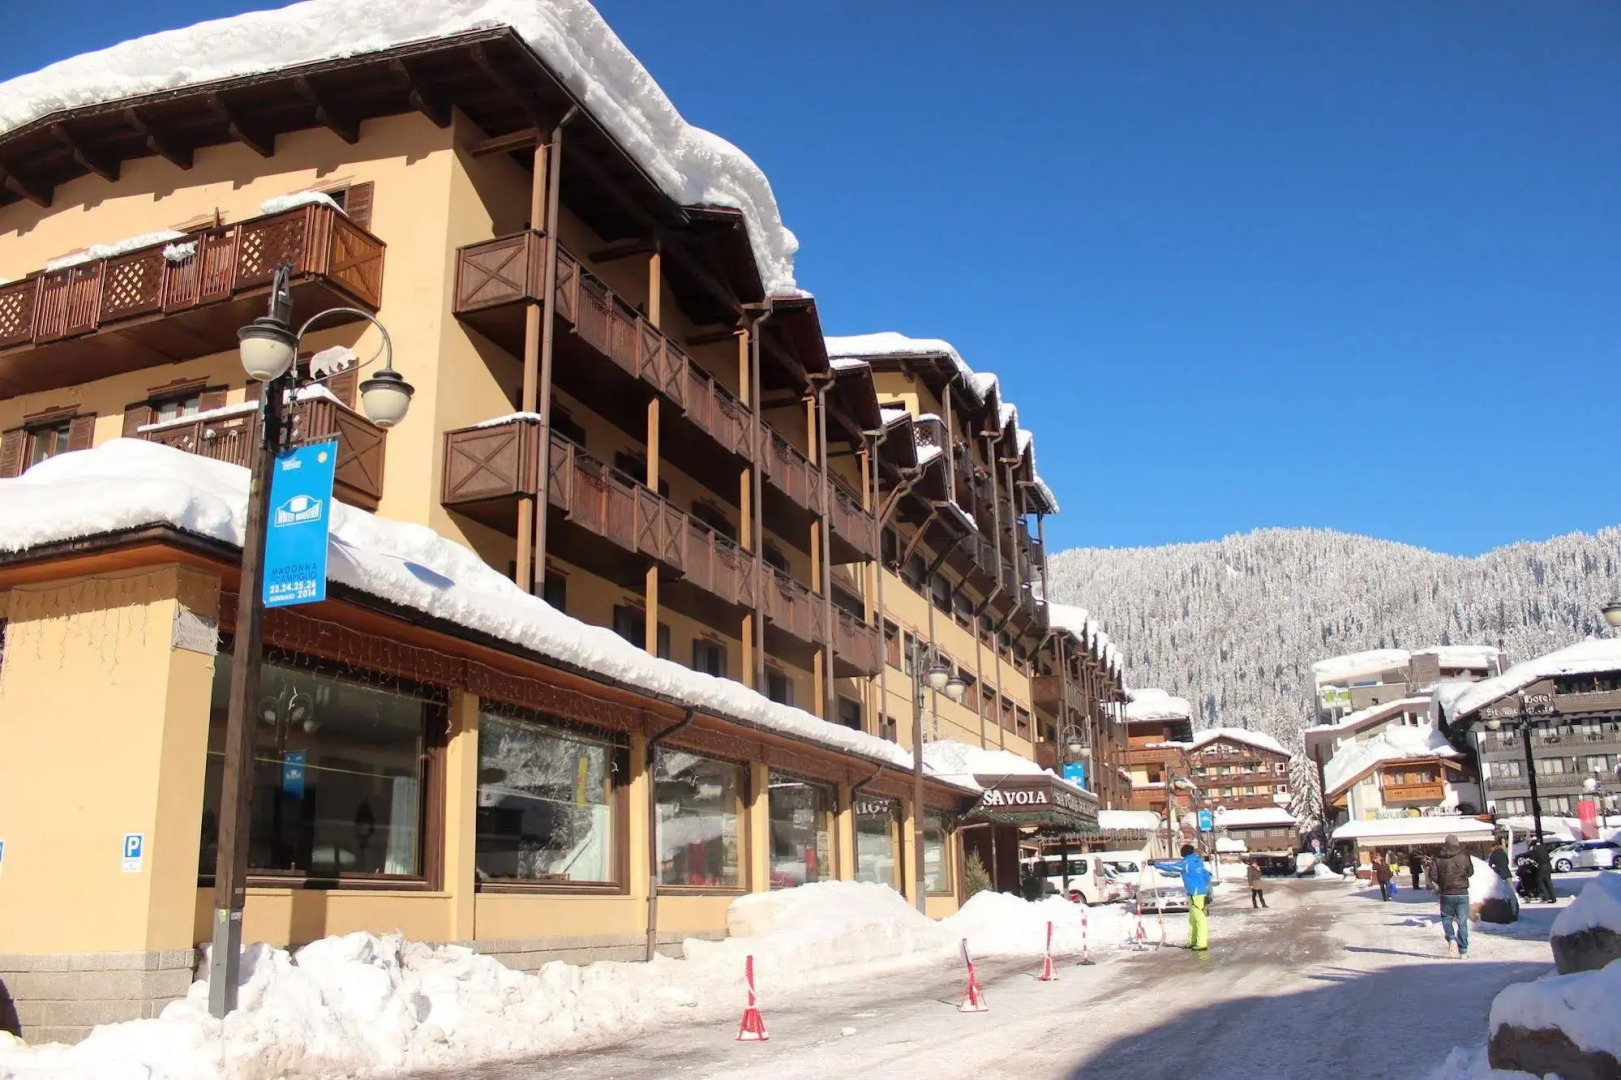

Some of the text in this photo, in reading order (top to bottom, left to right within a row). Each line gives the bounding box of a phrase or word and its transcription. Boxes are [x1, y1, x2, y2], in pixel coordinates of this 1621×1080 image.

[271, 562, 317, 576] MADONNA
[275, 571, 317, 584] CAMPIGLIO
[269, 579, 317, 594] 23.24.25.26
[297, 588, 317, 599] 2014
[982, 790, 1047, 806] SAVOIA
[127, 836, 140, 857] P
